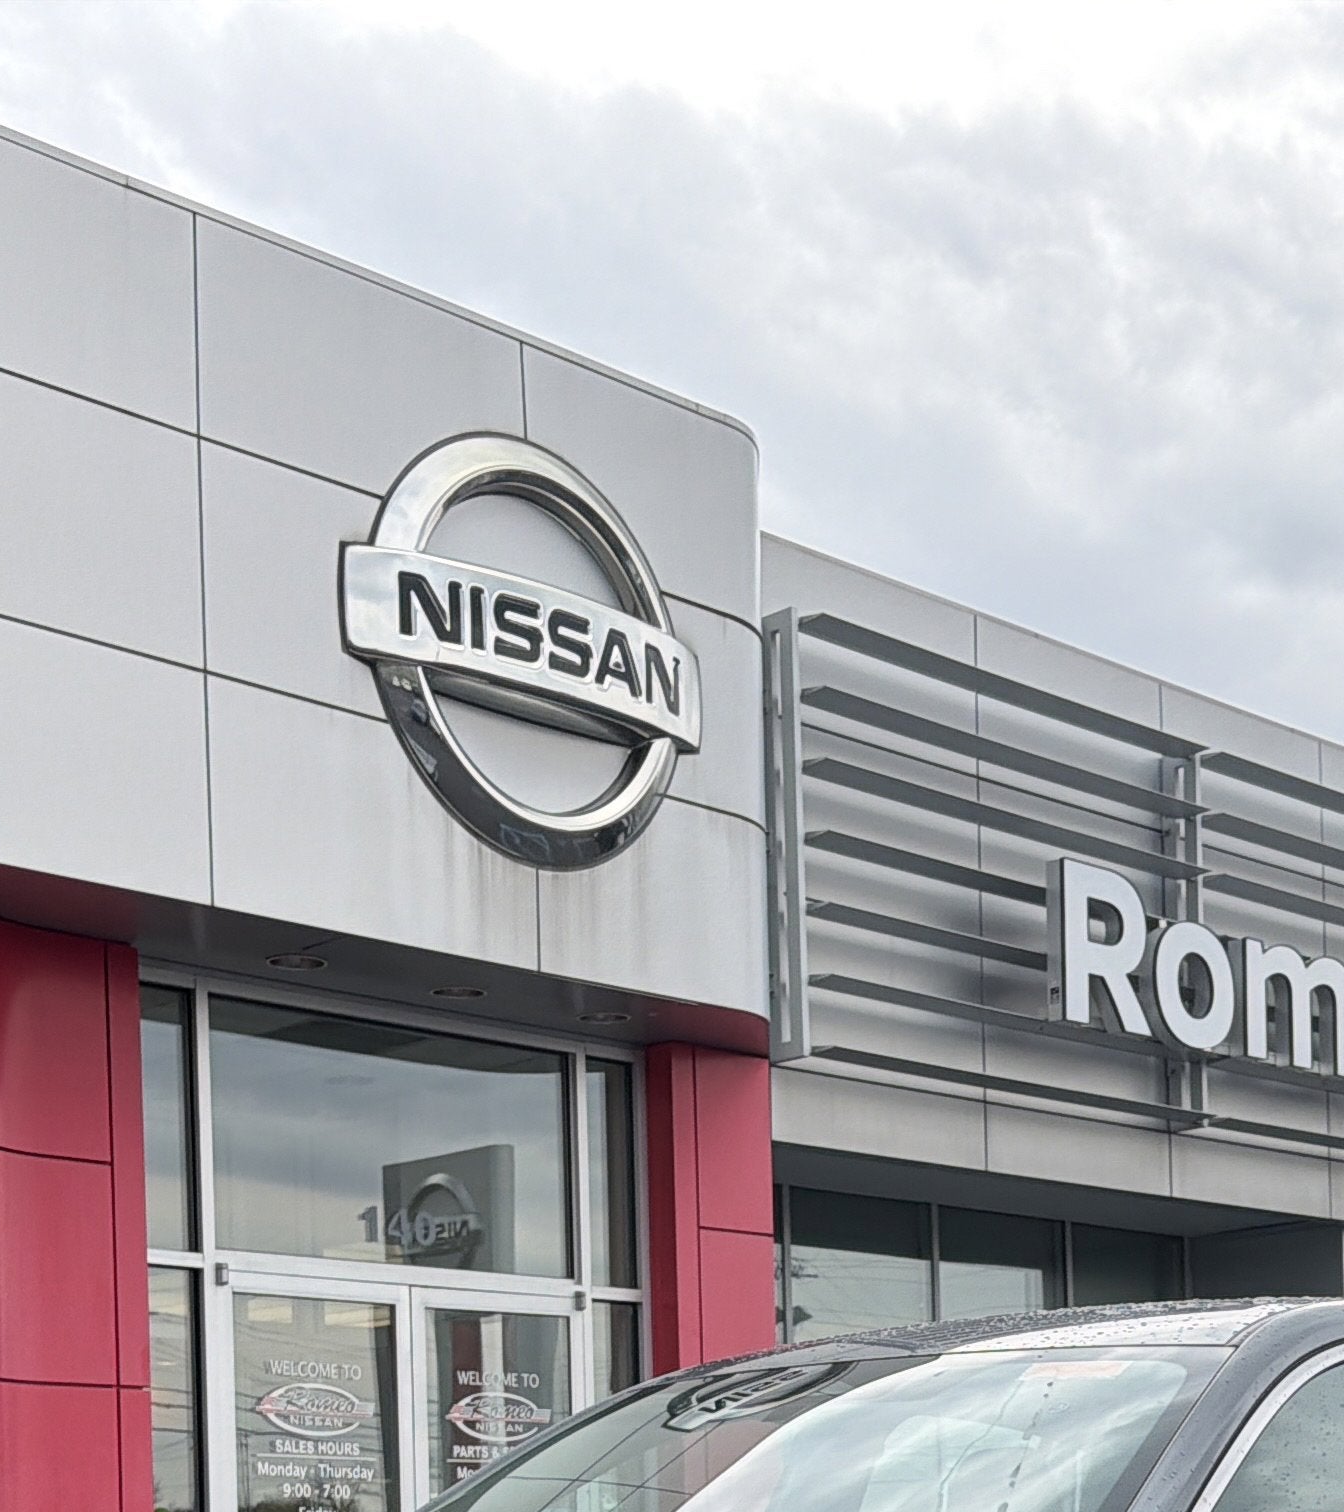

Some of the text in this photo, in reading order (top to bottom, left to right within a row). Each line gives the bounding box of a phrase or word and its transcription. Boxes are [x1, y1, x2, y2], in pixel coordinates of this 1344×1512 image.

[397, 570, 681, 717] NISSAN
[269, 1360, 362, 1380] WELCOME TO
[456, 1371, 540, 1389] WELCOME TO
[276, 1388, 357, 1414] Romeo
[289, 1414, 343, 1427] NISSAN
[275, 1439, 361, 1456] SALES HOURS
[452, 1445, 489, 1459] PARTS
[257, 1461, 308, 1480] Monday
[317, 1463, 375, 1482] Thursday
[282, 1483, 312, 1498] 9:00
[322, 1484, 351, 1499] 7:00
